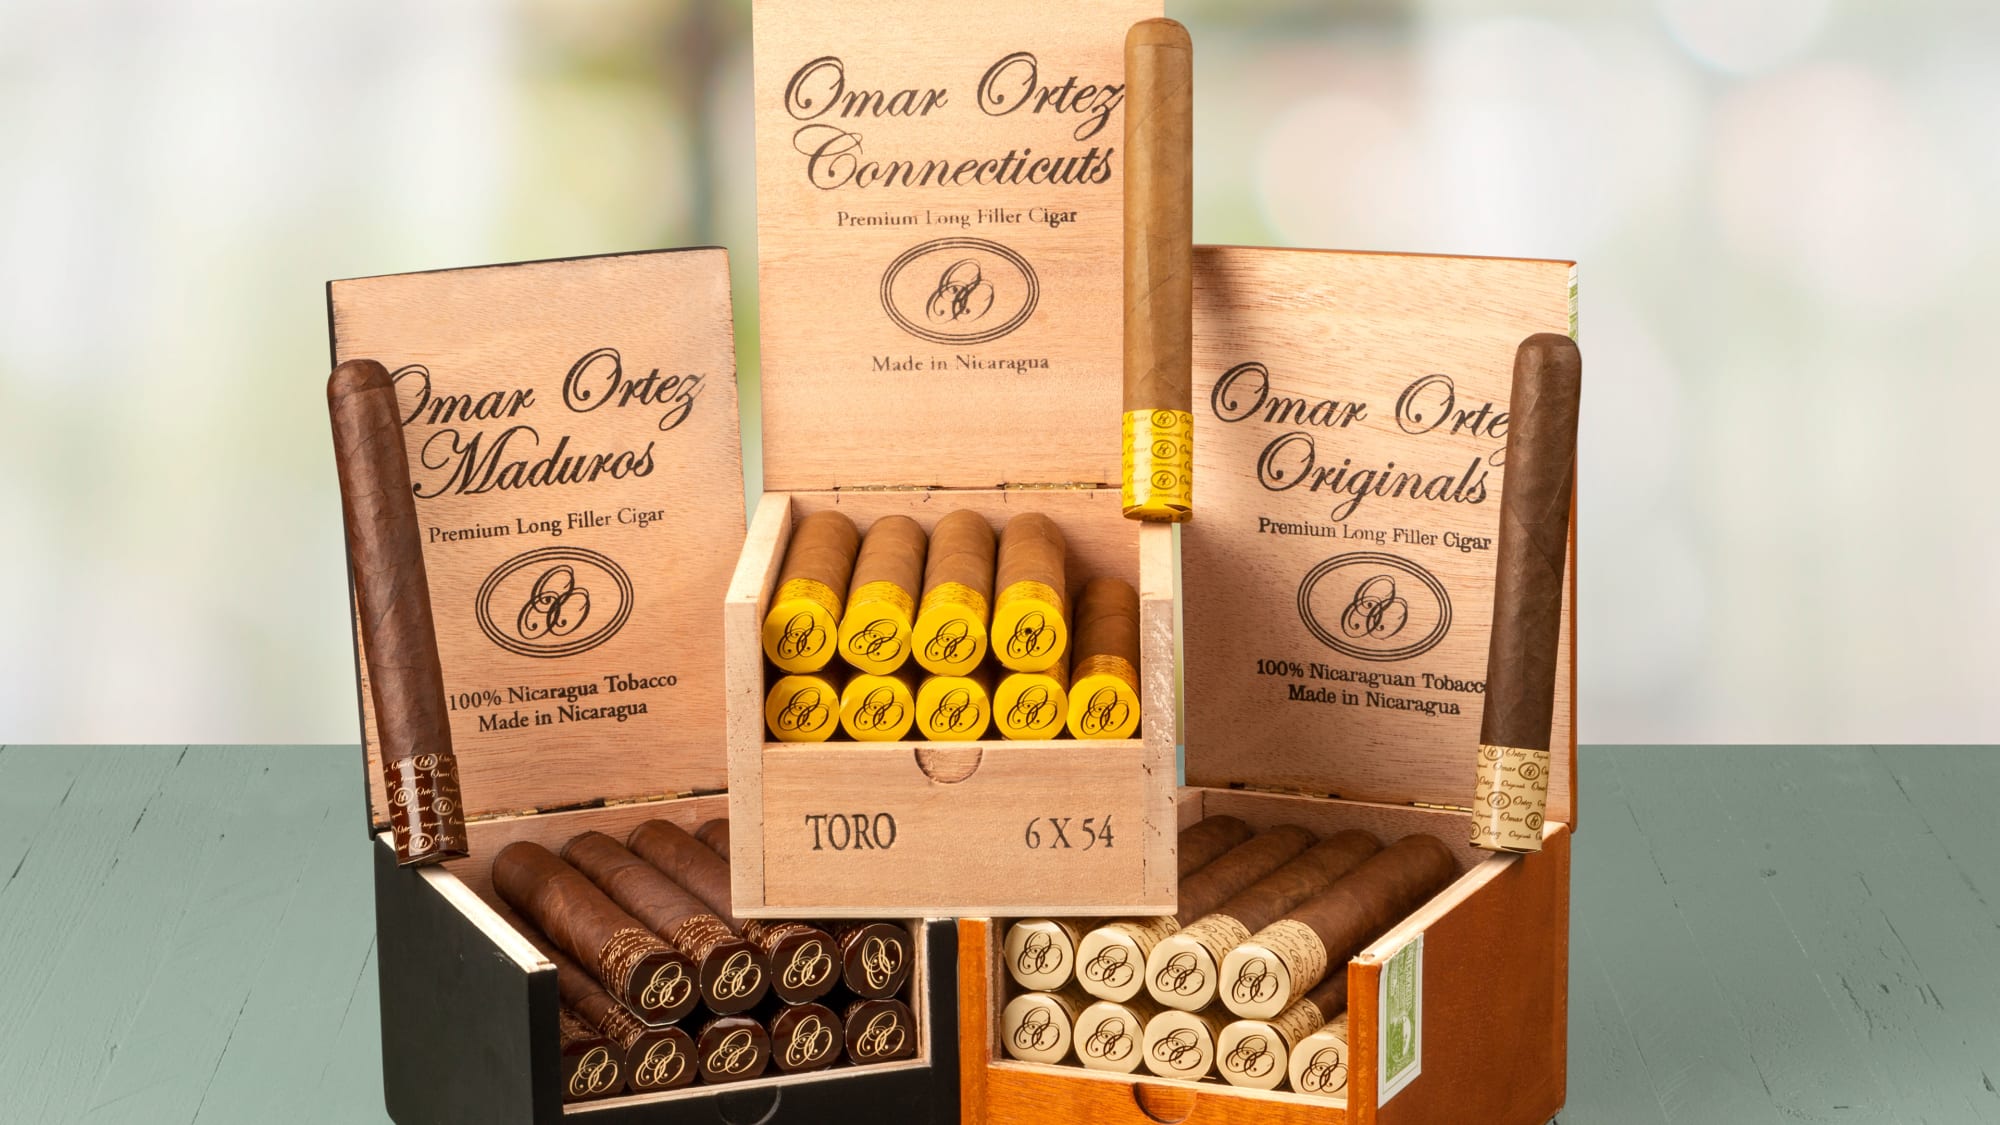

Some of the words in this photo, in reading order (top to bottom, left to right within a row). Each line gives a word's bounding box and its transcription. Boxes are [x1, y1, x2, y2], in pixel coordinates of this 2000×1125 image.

[785, 56, 948, 120] Omar
[977, 52, 1125, 141] Ortez
[793, 124, 1114, 190] Connecticuts
[838, 211, 917, 226] Premium
[926, 211, 970, 228] Long
[978, 209, 1021, 224] Filler
[1029, 208, 1077, 228] Cigar
[872, 356, 923, 371] Made
[930, 357, 948, 371] in
[956, 355, 1049, 374] Nicaragua
[563, 348, 706, 431] Ortez
[1211, 362, 1367, 426] Omar
[1395, 374, 1509, 467] Orte
[413, 426, 655, 499] Maduros
[1257, 431, 1488, 522] Originals
[429, 525, 509, 543] Premium
[516, 518, 562, 537] Long
[567, 511, 612, 530] Filler
[617, 508, 664, 528] Cigar
[1259, 517, 1337, 538] Premium
[1343, 524, 1386, 545] Long
[1393, 528, 1438, 546] Filler
[1443, 532, 1491, 552] Cigar
[449, 692, 502, 711] 100%
[508, 683, 598, 704] Nicaragua
[604, 673, 677, 693] Tobacco
[1257, 659, 1304, 678] 100%
[1309, 663, 1415, 688] Nicaraguan
[1422, 673, 1487, 693] Tobacc
[478, 714, 529, 732] Made
[535, 713, 553, 726] in
[558, 701, 648, 722] Nicaragua
[1288, 684, 1336, 704] Made
[1341, 688, 1359, 706] in
[1366, 691, 1460, 716] Nicaragua
[806, 812, 897, 850] TORO
[1025, 817, 1040, 849] 6
[1049, 818, 1071, 848] X
[1082, 815, 1114, 850] 54
